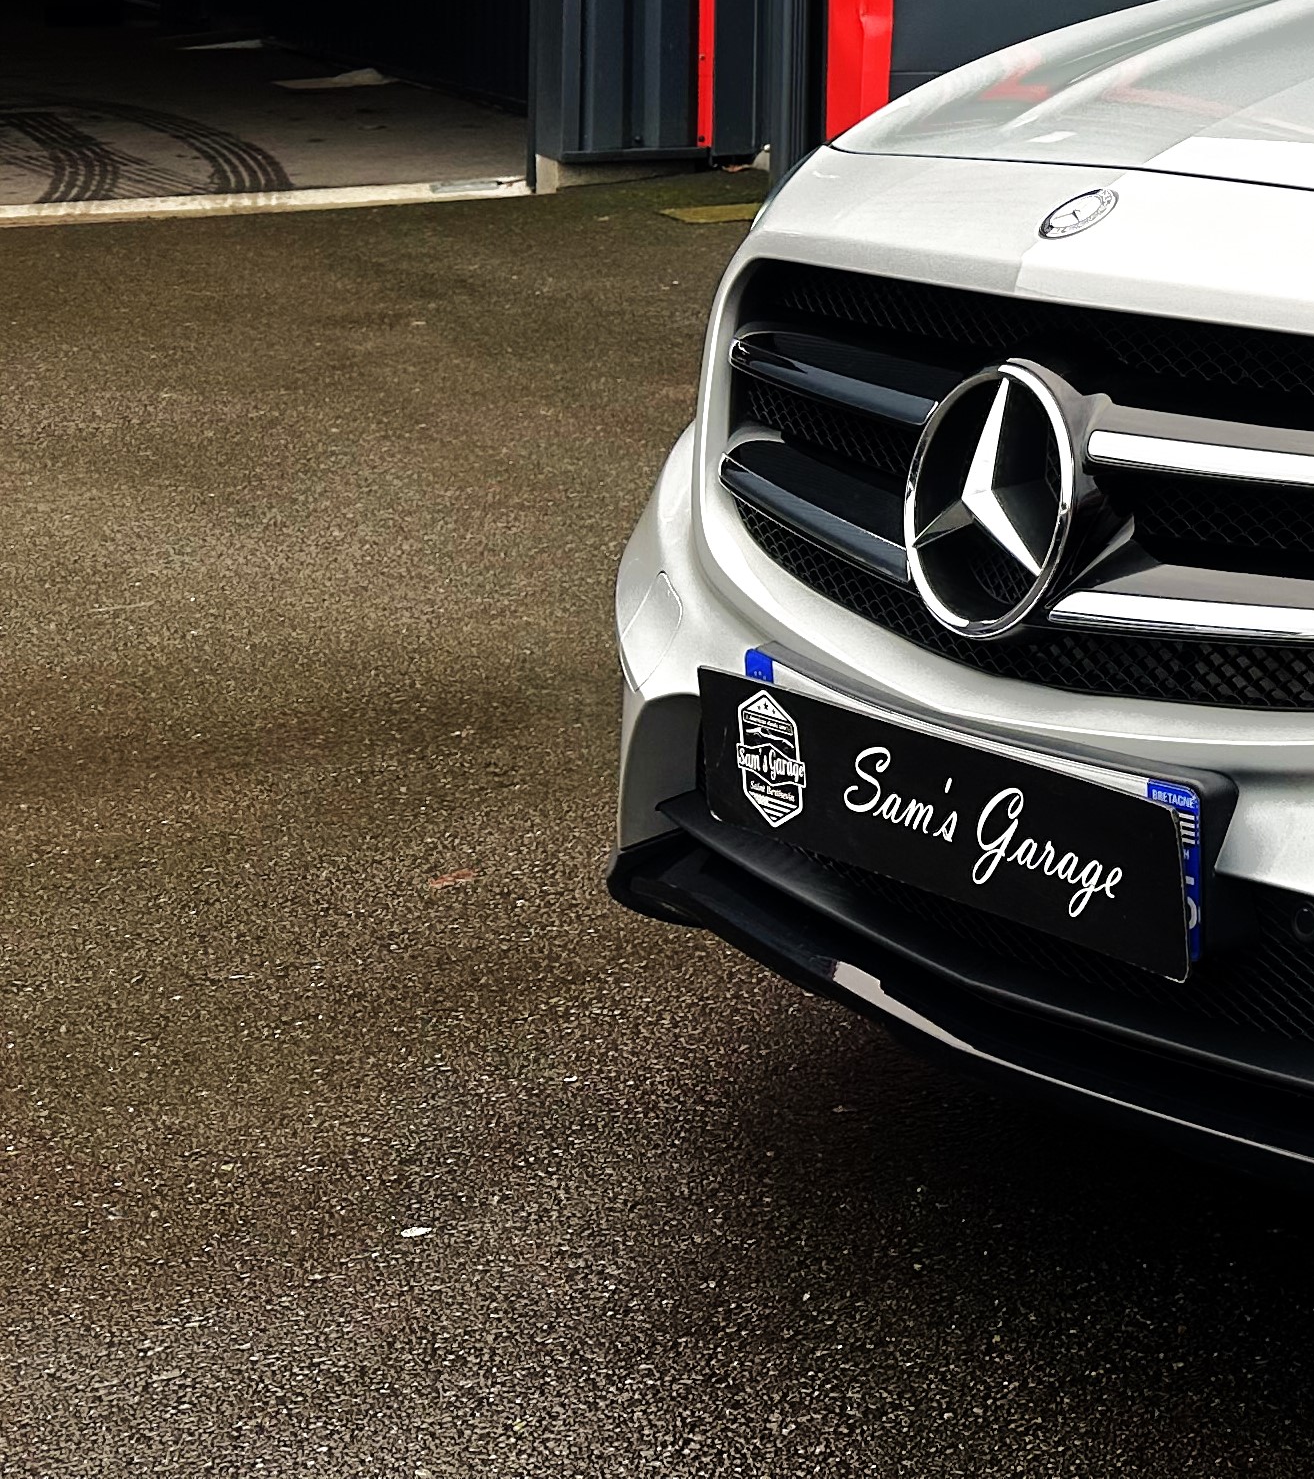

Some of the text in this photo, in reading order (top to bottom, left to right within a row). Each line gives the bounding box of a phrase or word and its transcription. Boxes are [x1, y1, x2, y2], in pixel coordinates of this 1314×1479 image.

[844, 747, 956, 843] Sam's
[972, 787, 1123, 917] Garage
[1151, 789, 1195, 809] BRETAGNE
